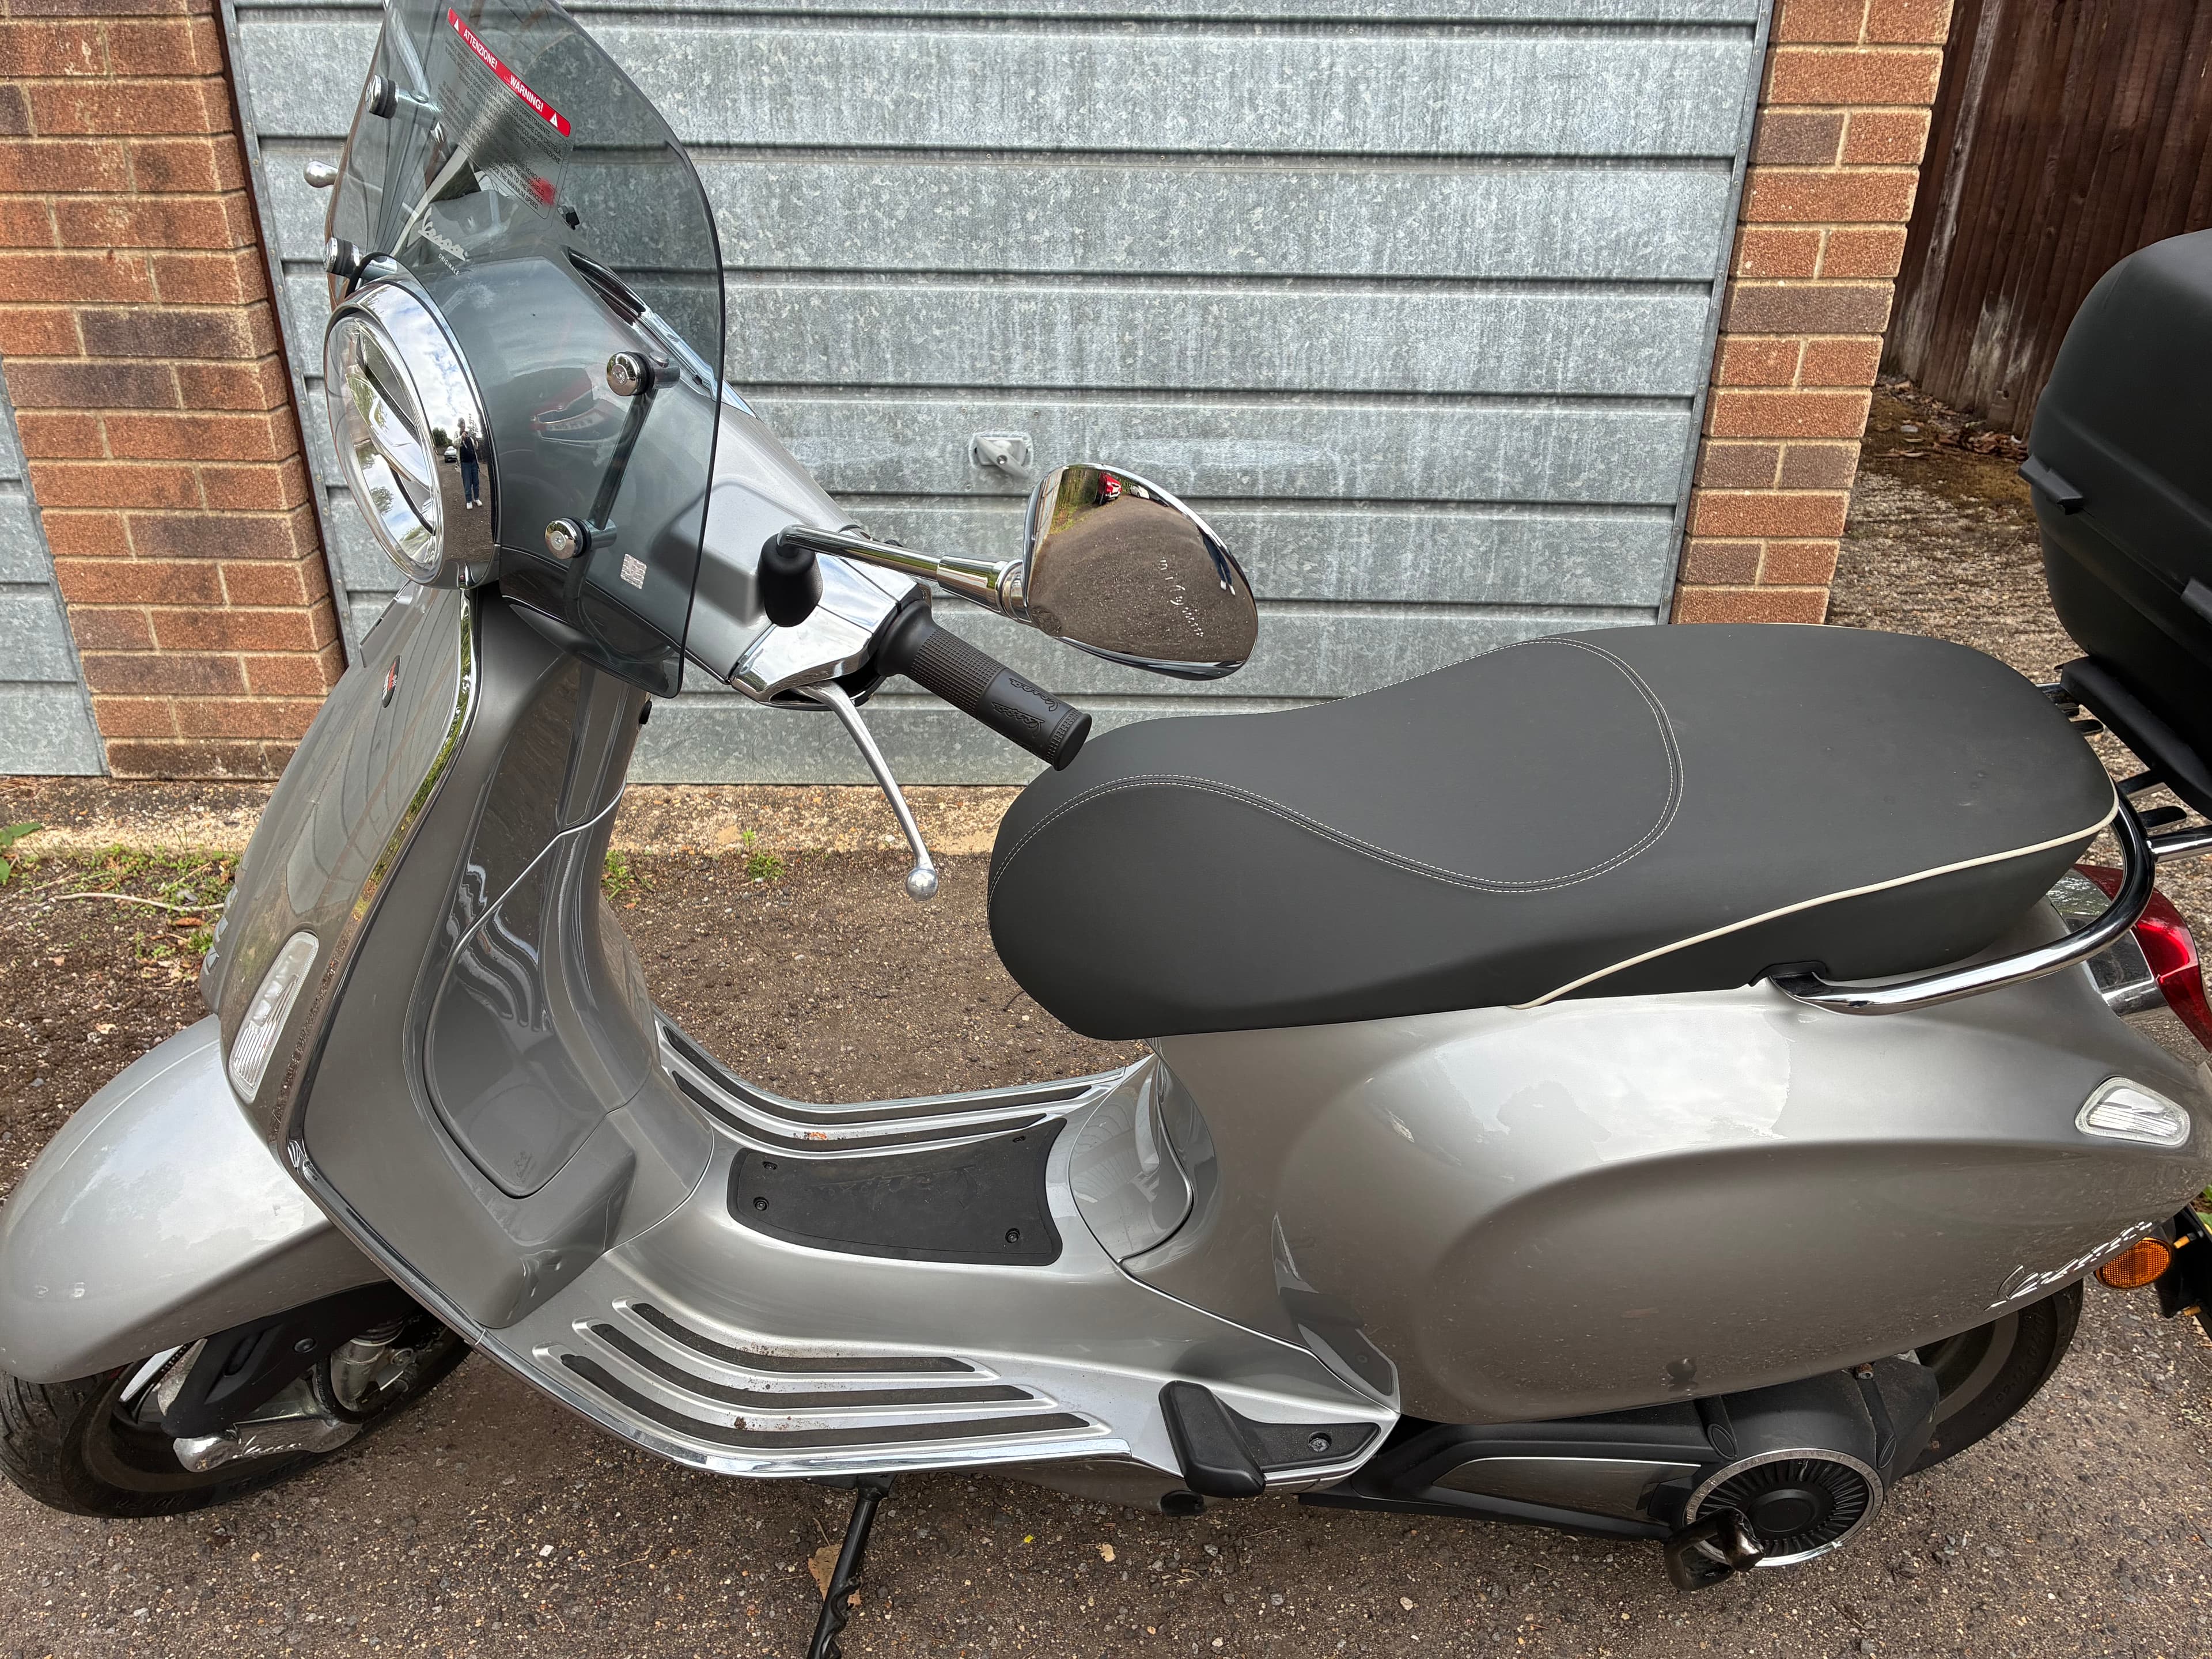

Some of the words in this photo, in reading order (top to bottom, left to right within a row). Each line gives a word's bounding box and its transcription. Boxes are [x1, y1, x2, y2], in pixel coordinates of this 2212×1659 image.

[463, 28, 498, 71] ATTENZIONE!
[509, 73, 544, 113] WARNING!
[499, 171, 507, 183] THE
[506, 177, 525, 199] MAXIMUM
[525, 194, 540, 211] SPEED.
[513, 174, 520, 184] TO
[518, 179, 528, 191] THE
[417, 207, 465, 262] Vespa
[437, 252, 460, 276] ORIGINALE
[1009, 677, 1059, 712] Vespa
[992, 702, 1046, 739] Vespa
